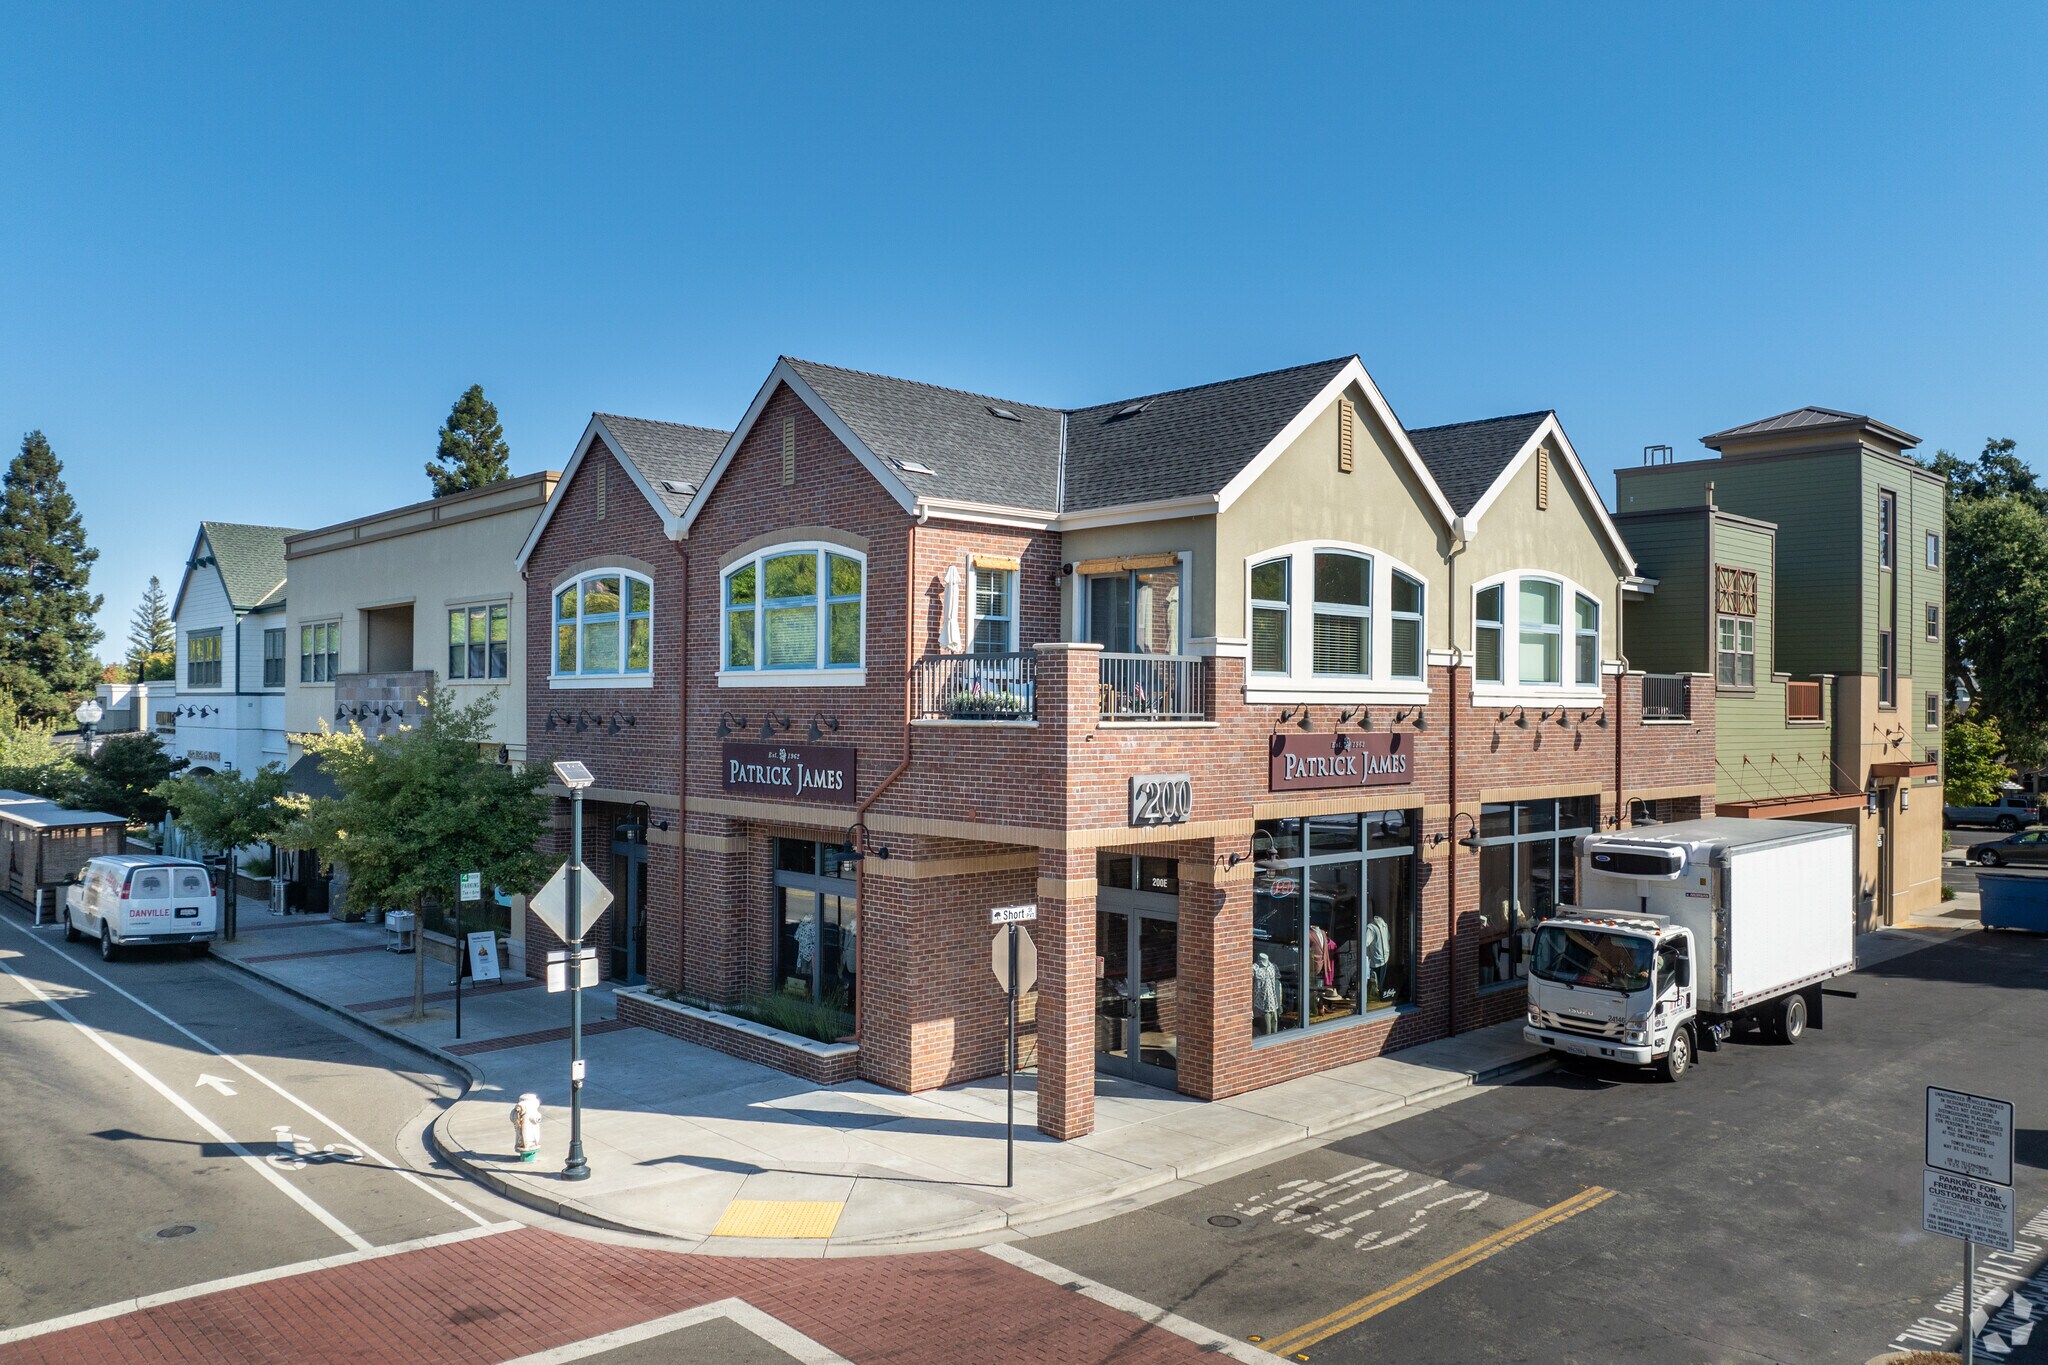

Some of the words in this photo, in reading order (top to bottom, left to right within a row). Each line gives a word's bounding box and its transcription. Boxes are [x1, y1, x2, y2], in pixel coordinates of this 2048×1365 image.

[768, 751, 779, 759] Est.
[1144, 781, 1193, 818] 200
[1152, 878, 1168, 888] 200E
[130, 909, 170, 917] DANVILLE
[1004, 909, 1024, 920] Short
[1568, 1008, 1594, 1016] ISUZU
[1608, 1014, 1625, 1023] 24146
[1935, 1092, 1965, 1102] UNAUTHORIZED
[1966, 1098, 1986, 1106] VEHICLES
[1947, 1099, 1970, 1109] DESIGNATED
[1972, 1104, 1997, 1114] ACCESSIBLE
[1938, 1108, 1970, 1119] DISTINGUISHING
[1971, 1115, 1992, 1124] PLACARDS
[1970, 1109, 1994, 1119] DISPLAYING
[1945, 1120, 1964, 1128] PERSONS
[1976, 1127, 2002, 1137] DISABILITIES
[1958, 1133, 1975, 1142] OWNER'S
[1976, 1138, 1995, 1146] EXPENSE
[1962, 1148, 1987, 1158] RECLAIMED
[1966, 1143, 1985, 1152] VEHICLES
[1961, 1161, 1989, 1172] TELEPHONING
[1939, 1175, 1976, 1189] PARKING
[1980, 1184, 1996, 1194] FOR
[1934, 1181, 1974, 1196] FREMONT
[1978, 1191, 2002, 1202] BANK
[1929, 1187, 1981, 1205] CUSTOMERS
[1984, 1199, 2007, 1211] ONLY
[1936, 1198, 1961, 1208] VIOLATORS
[1983, 1208, 2000, 1217] TOWED
[1940, 1204, 1957, 1212] VEHICLE
[1982, 1214, 2003, 1223] EXPENSE
[1937, 1216, 1964, 1226] INFORMATION
[1988, 1228, 2007, 1237] VEHICLES
[1938, 1221, 1956, 1230] DANVILLE
[1955, 1231, 1971, 1239] TOWING
